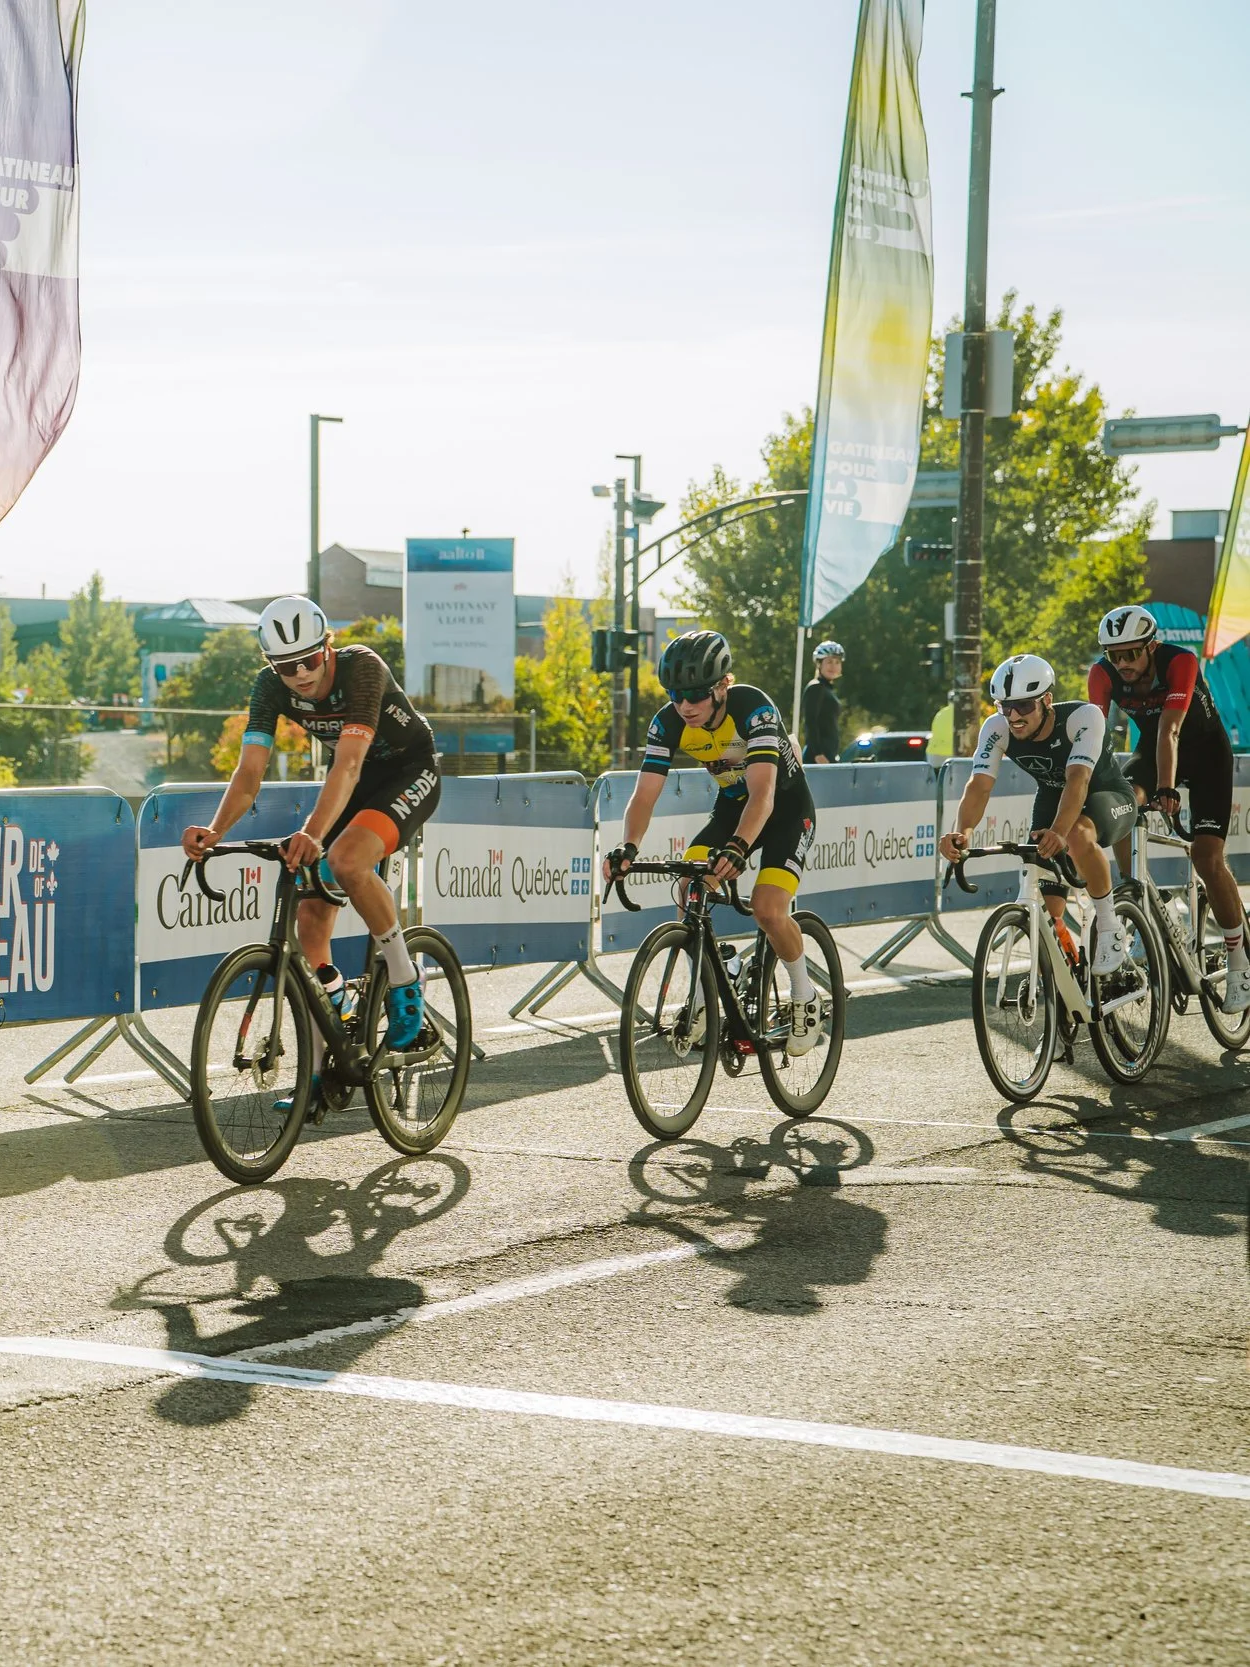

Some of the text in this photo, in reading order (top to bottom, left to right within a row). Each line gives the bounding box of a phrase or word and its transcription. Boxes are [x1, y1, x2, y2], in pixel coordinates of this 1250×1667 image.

[829, 441, 915, 466] GATINEAU
[825, 460, 877, 479] POUR
[824, 479, 848, 495] LA
[825, 500, 854, 516] VIE
[29, 838, 45, 873] DE
[864, 828, 914, 869] Québec
[34, 875, 45, 898] OF
[435, 848, 569, 903] Canada Québec
[157, 867, 261, 930] Canada
